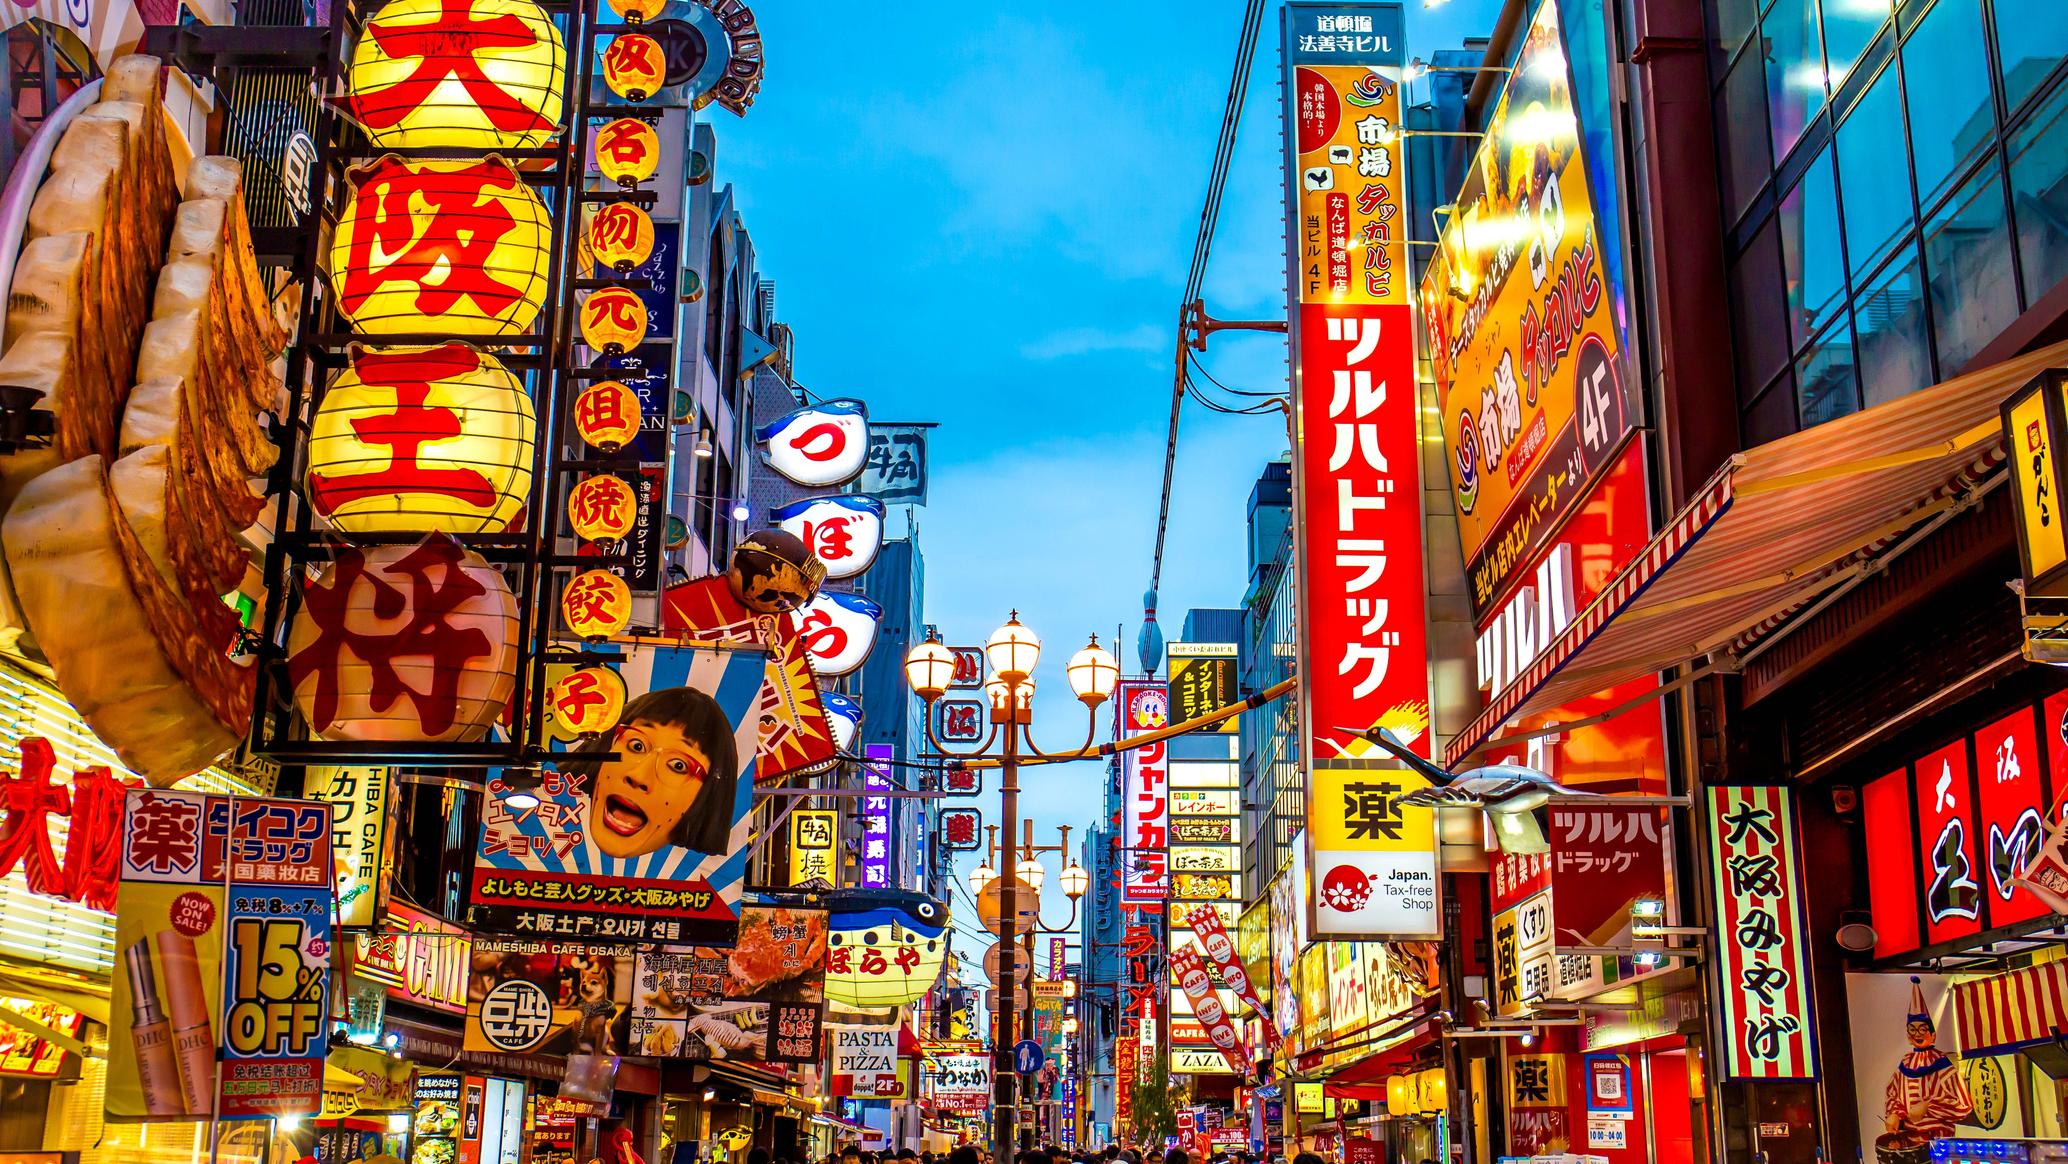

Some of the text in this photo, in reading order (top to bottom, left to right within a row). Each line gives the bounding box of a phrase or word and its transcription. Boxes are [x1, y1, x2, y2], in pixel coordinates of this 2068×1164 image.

[1317, 15, 1373, 33] 道頓堀
[1299, 35, 1392, 53] 法善寺ビル
[1314, 83, 1326, 137] 韓国本場より
[1330, 196, 1348, 294] なんば道頓堀店
[1582, 360, 1610, 453] 4F
[1325, 318, 1400, 700] ツルハドラッグ
[1475, 542, 1573, 702] ツルハ
[1178, 802, 1226, 812] レインボー
[1344, 782, 1403, 840] 薬
[208, 802, 326, 841] ダイコク
[1554, 812, 1658, 844] ツルハ
[130, 792, 198, 870] 薬
[801, 821, 830, 842] 牛角
[359, 823, 376, 878] CAFE
[483, 829, 583, 860] ショップ
[1557, 851, 1639, 873] ドラッグ
[1388, 869, 1432, 888] Japan.
[1383, 884, 1433, 896] Tax-free
[180, 896, 210, 911] NOW
[181, 905, 203, 920] ON
[234, 898, 266, 914] 免税
[1402, 897, 1433, 912] Shop
[175, 914, 208, 932] SALE!
[652, 920, 681, 940] 선물
[1195, 920, 1212, 936] B1
[1523, 903, 1546, 940] くすり
[1725, 802, 1799, 1059] 大阪みやげ
[772, 924, 808, 940] 螃蟹
[475, 941, 632, 957] MAMESHIBA CAFE OSAKA
[1208, 938, 1228, 952] CAFE
[236, 921, 323, 1001] 15%
[1497, 922, 1518, 1006] 薬
[1184, 973, 1206, 989] CAFE
[1225, 971, 1242, 985] INFO
[1198, 1001, 1219, 1017] INFO
[229, 1002, 320, 1053] OFF
[1172, 1029, 1210, 1038] CAFE&
[135, 1031, 168, 1048] DHC
[178, 1031, 209, 1050] DHC
[838, 1031, 895, 1047] PASTA
[859, 1047, 870, 1056] &
[1181, 1054, 1224, 1067] ZAZA
[839, 1056, 894, 1071] PIZZA
[936, 1064, 988, 1087] わなか
[1515, 1059, 1549, 1101] 薬
[876, 1079, 894, 1092] 2F
